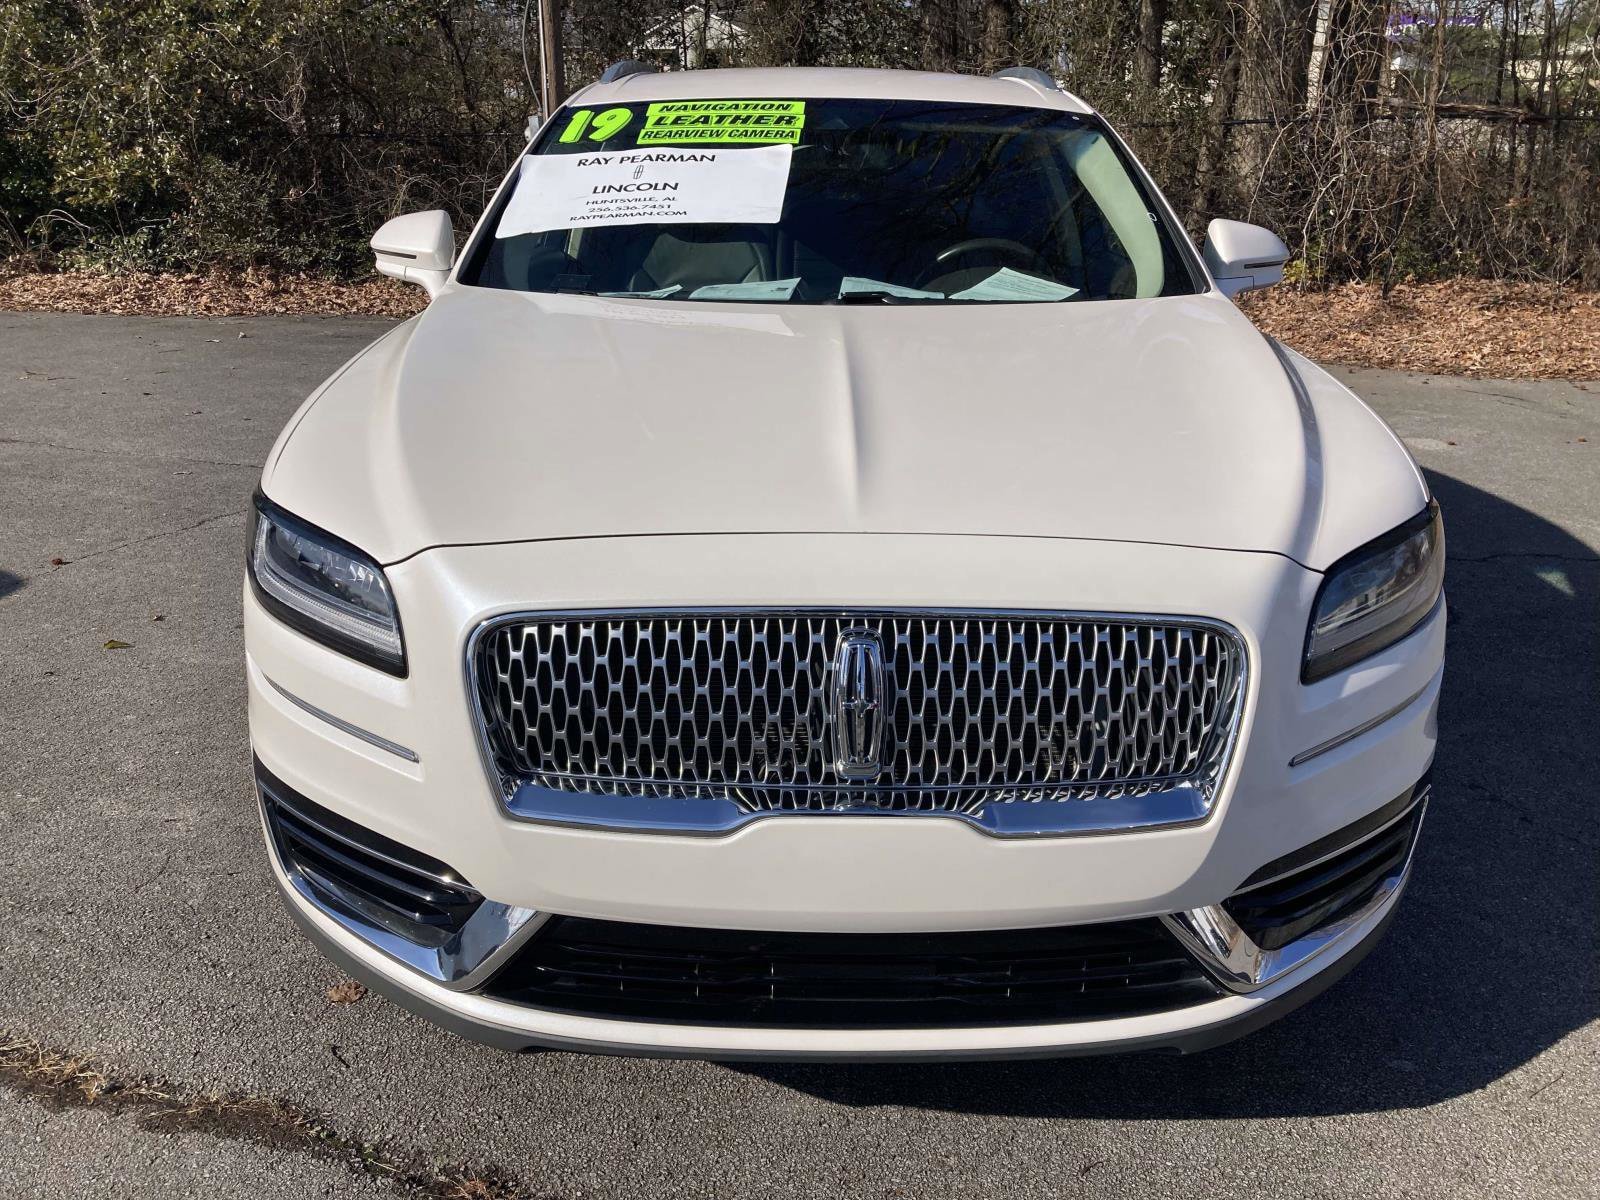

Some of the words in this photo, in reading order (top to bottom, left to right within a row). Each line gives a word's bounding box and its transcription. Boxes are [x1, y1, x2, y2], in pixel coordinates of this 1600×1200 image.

[658, 102, 794, 113] NAVIGATION
[558, 107, 634, 145] 19
[652, 114, 799, 127] LEATHER
[641, 128, 727, 140] REARVIEW
[727, 129, 797, 140] CAMERA
[577, 157, 615, 167] RAY
[619, 153, 716, 164] PEARMAN
[592, 182, 679, 194] LINCOLN
[586, 196, 658, 205] HUNTSVILLE,
[588, 204, 672, 213] 256.536.7451
[570, 210, 688, 221] RAYPEARMAN.COM
